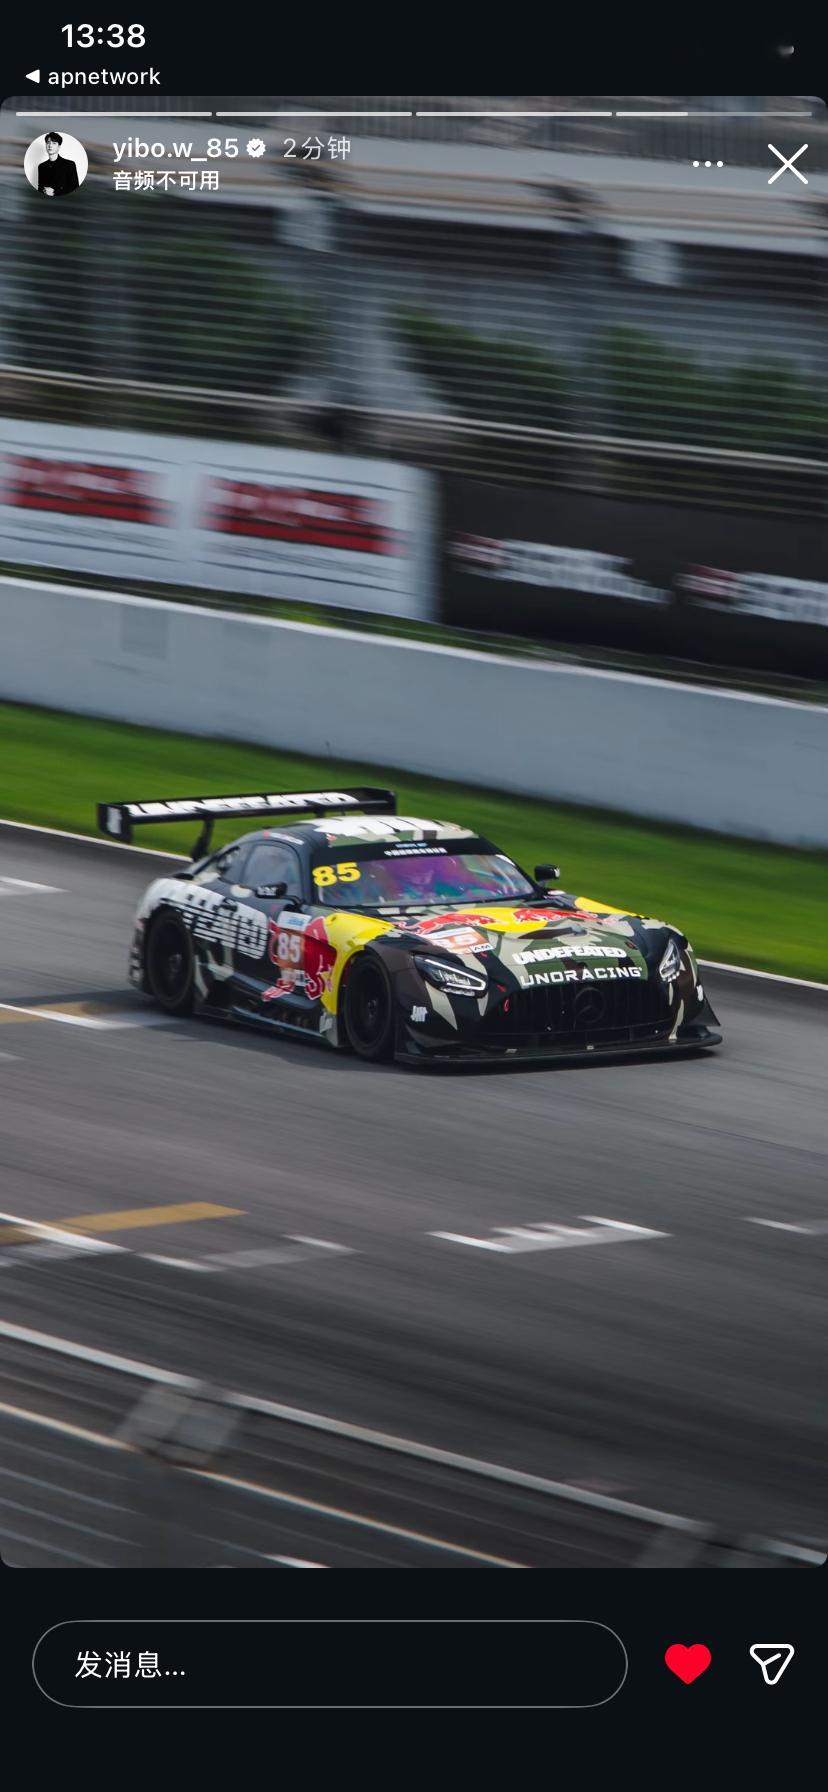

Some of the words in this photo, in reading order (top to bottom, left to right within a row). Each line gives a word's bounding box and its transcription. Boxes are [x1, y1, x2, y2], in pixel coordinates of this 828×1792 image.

[312, 862, 360, 886] 85
[278, 932, 300, 962] 85
[512, 945, 628, 964] UNDEFEATED
